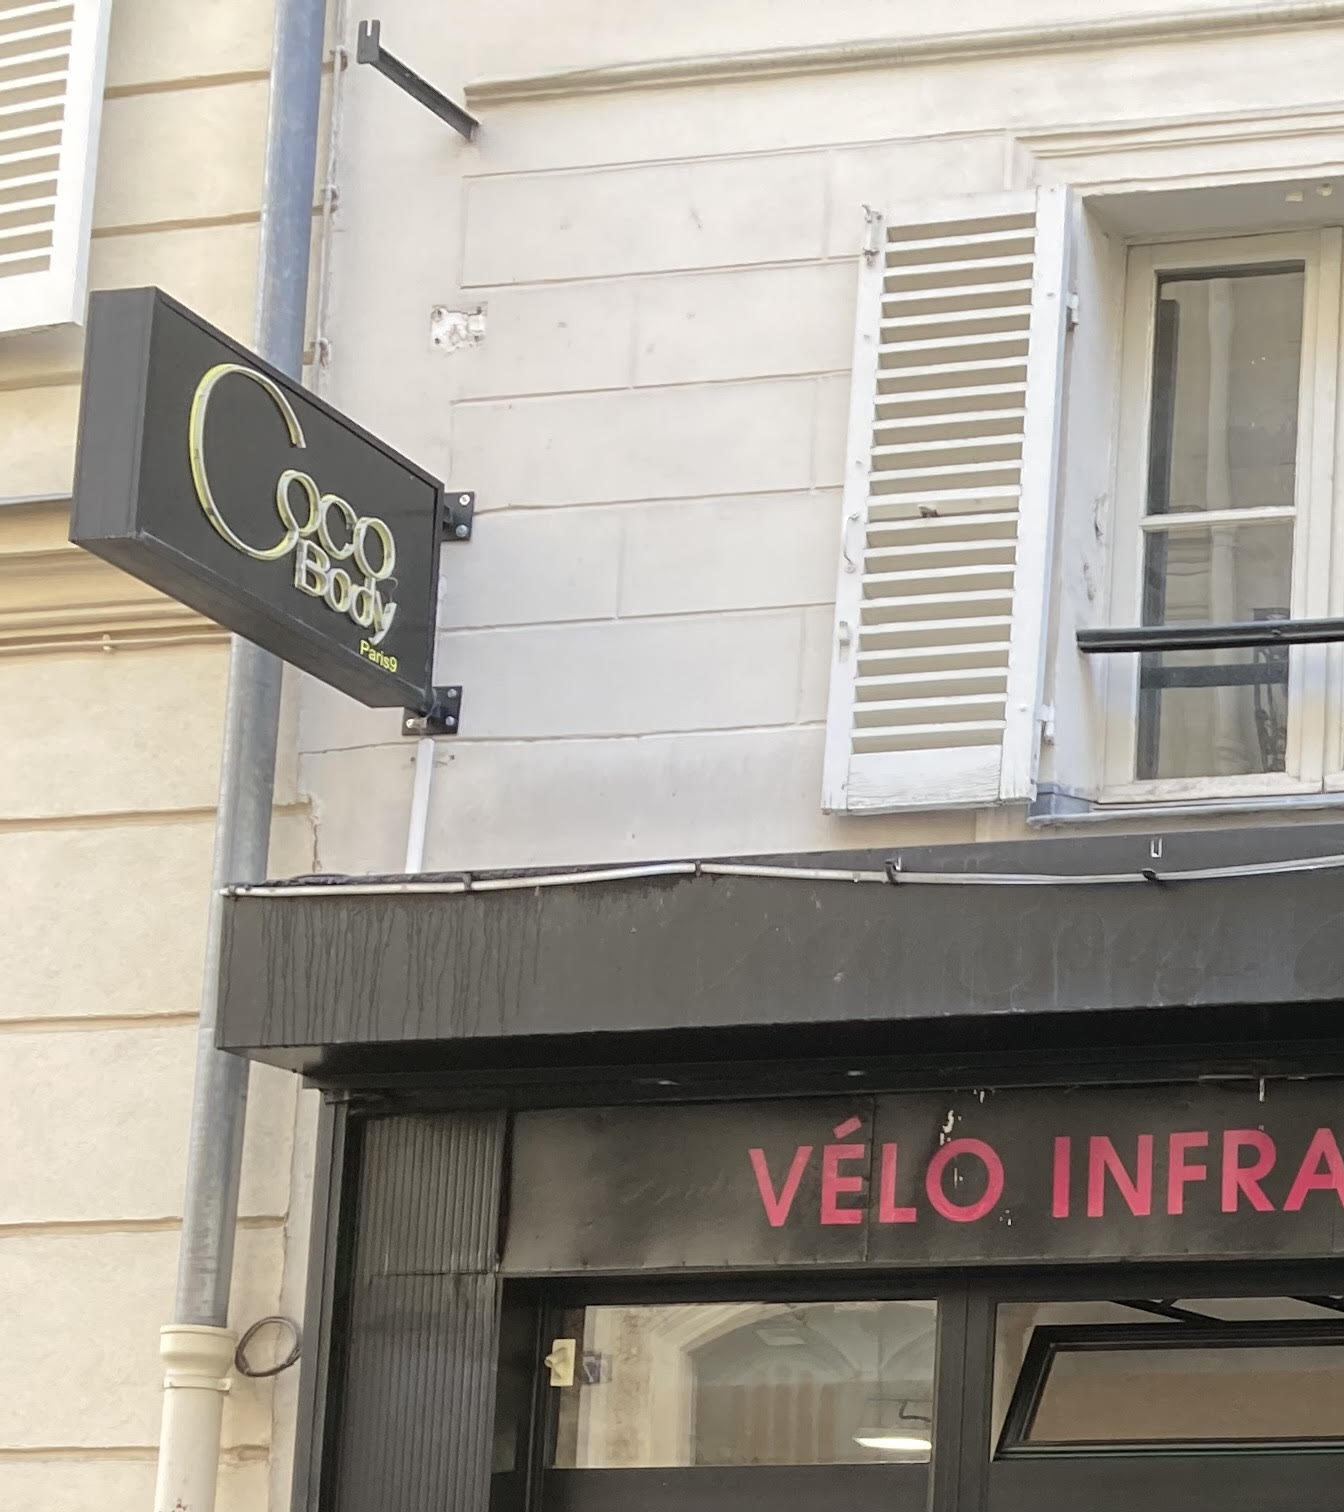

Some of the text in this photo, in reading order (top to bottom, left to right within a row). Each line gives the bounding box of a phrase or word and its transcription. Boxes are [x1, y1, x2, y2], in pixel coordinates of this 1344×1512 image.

[189, 363, 396, 580] Coco
[294, 540, 397, 646] Body
[359, 638, 398, 673] Paris9
[748, 1116, 1006, 1228] VÉLO
